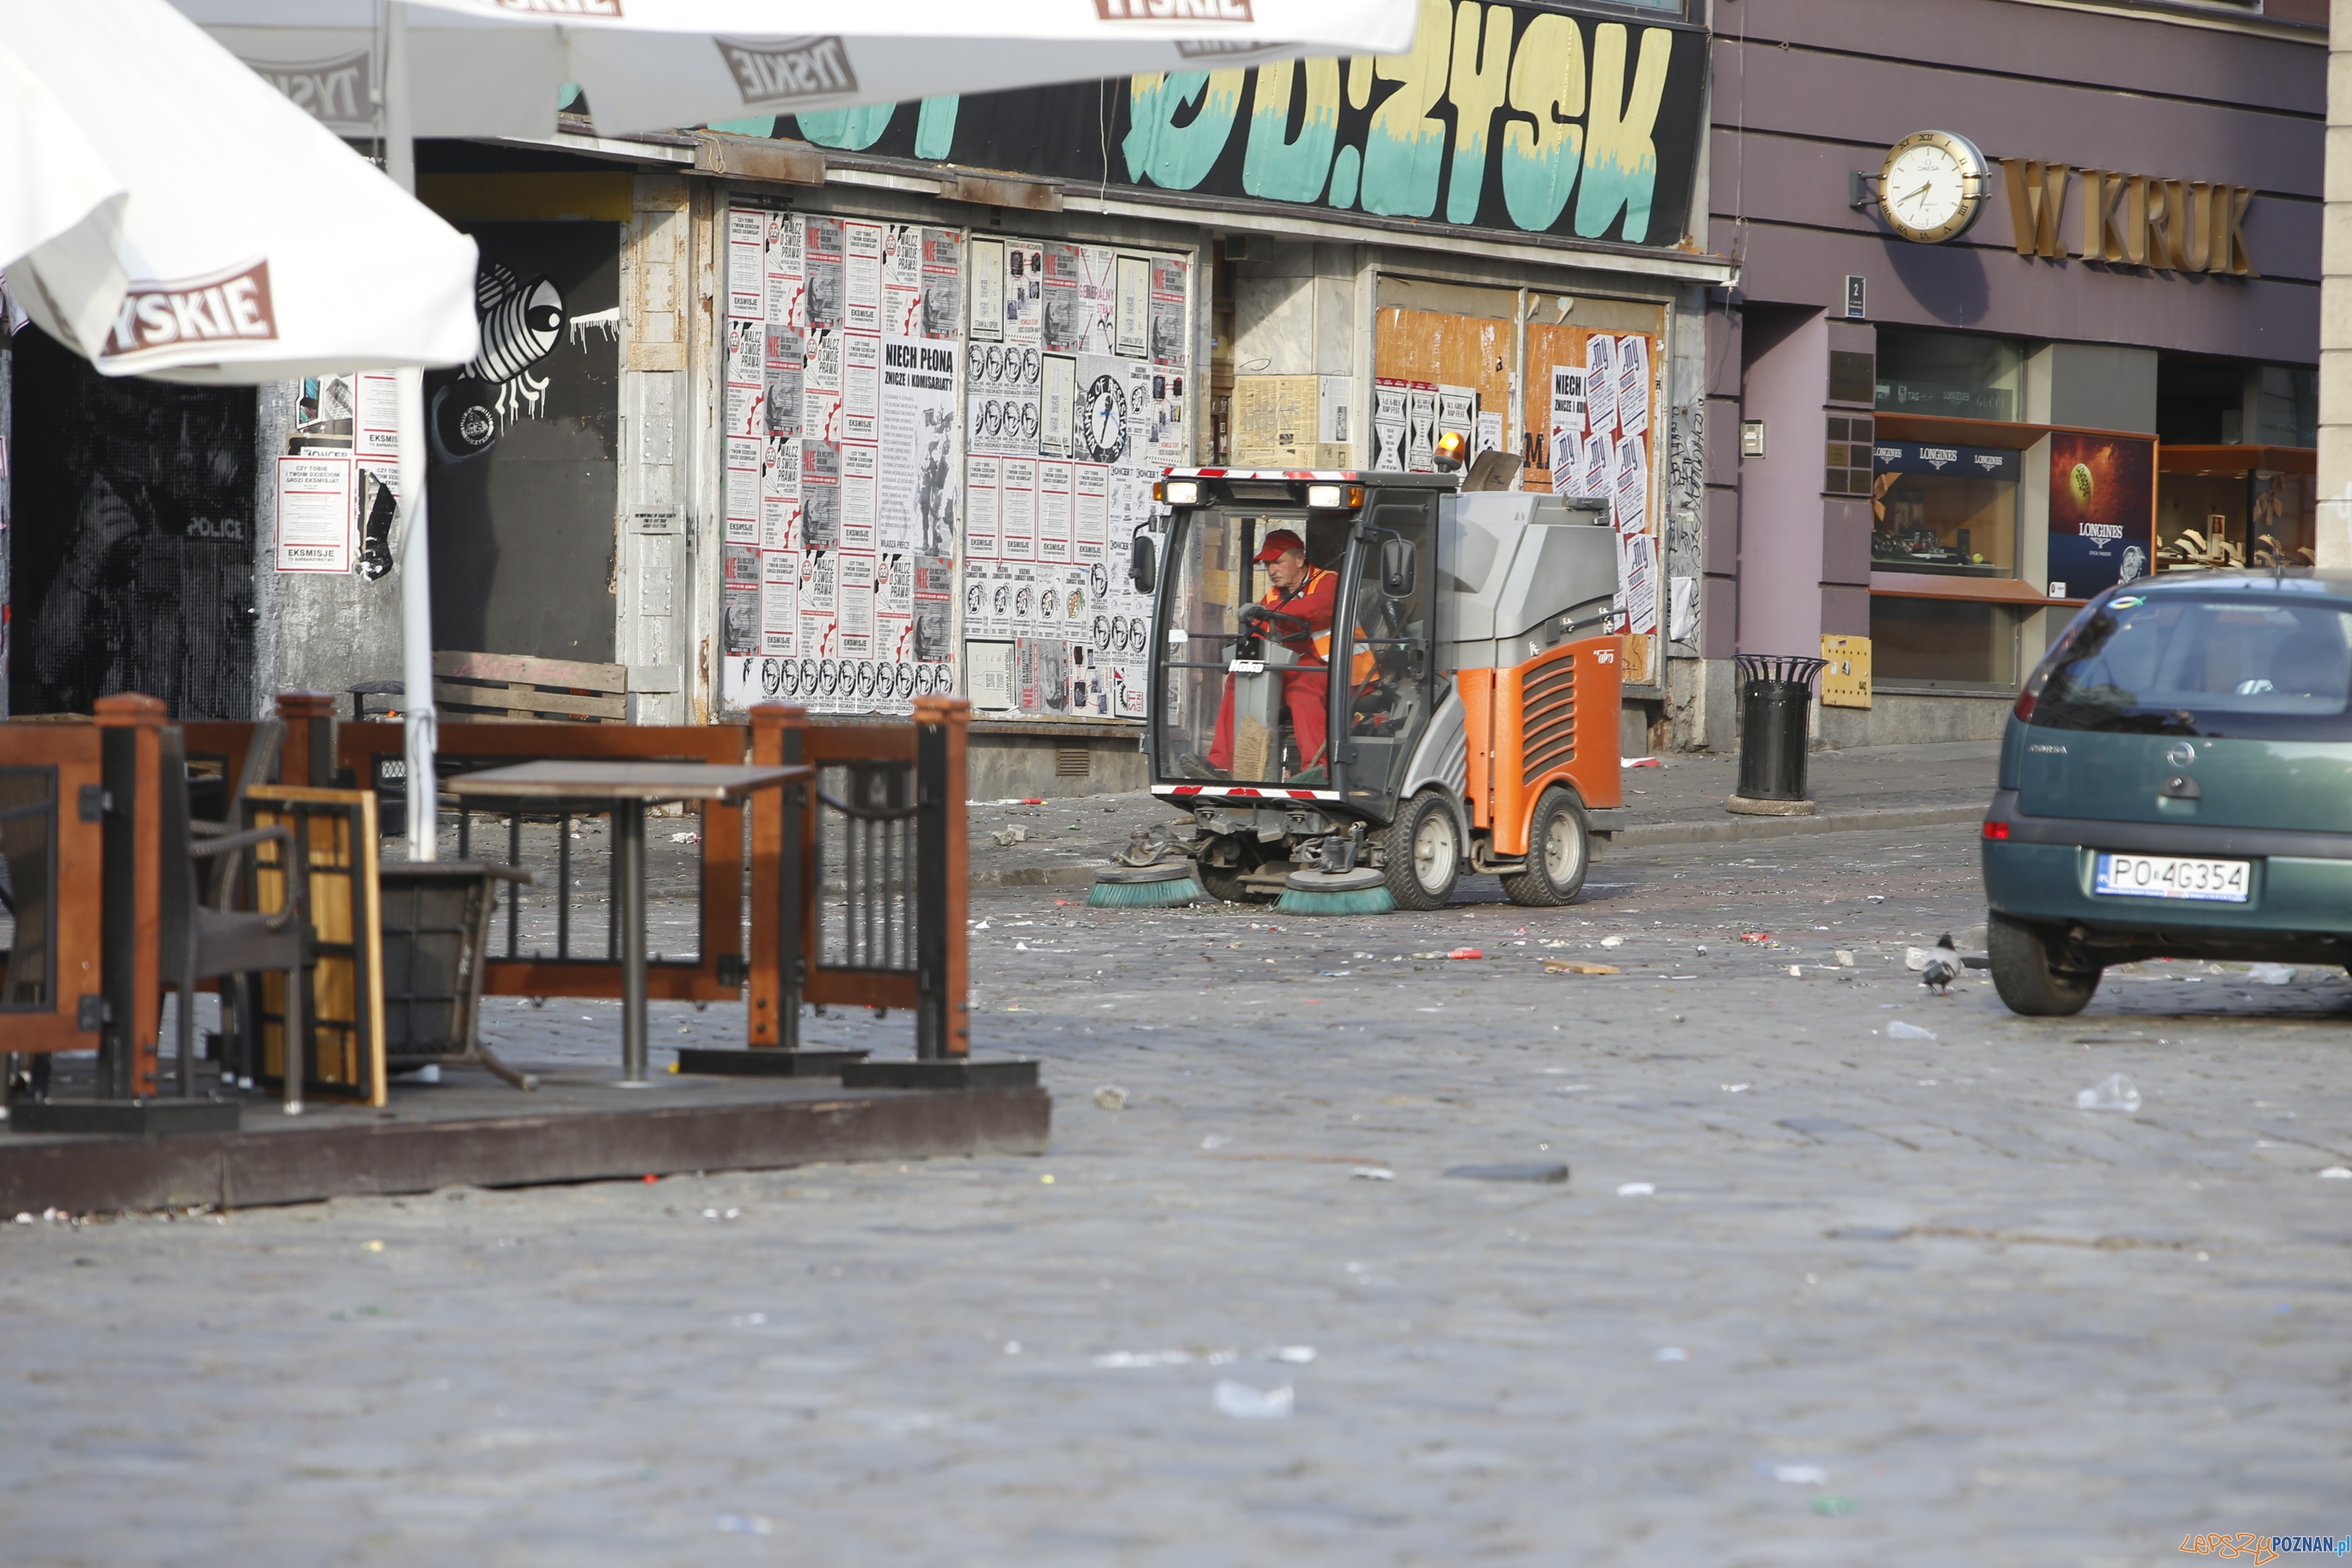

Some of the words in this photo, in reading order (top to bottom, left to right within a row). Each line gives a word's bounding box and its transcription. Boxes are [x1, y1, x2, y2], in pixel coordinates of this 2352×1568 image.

[1899, 139, 1910, 150] XI
[2000, 158, 2072, 257] W.
[2079, 168, 2259, 278] KRUK
[784, 221, 802, 235] WALCZ
[785, 235, 801, 247] SWOJE
[901, 233, 918, 247] WALCZ
[901, 248, 917, 259] SWOJE
[1080, 285, 1114, 301] GENERALNY
[1853, 284, 1859, 296] 2
[734, 297, 757, 306] EKSMISJE
[107, 276, 269, 352] YSKIE
[851, 309, 874, 318] EKSMISJE
[1097, 303, 1114, 315] STRAJK
[744, 330, 762, 344] WALCZ
[744, 344, 762, 355] SWOJE
[822, 337, 840, 351] WALCZ
[823, 351, 839, 362] SWOJE
[885, 344, 917, 369] NIECH
[920, 347, 953, 377] PŁONĄ
[885, 371, 906, 386] ZNICZE
[911, 374, 952, 391] KOMISARIATY
[1095, 378, 1106, 395] OF
[1556, 375, 1581, 396] NIECH
[1554, 399, 1571, 412] ZNICZE
[848, 420, 872, 428] EKSMISJE
[781, 445, 799, 457] WALCZ
[1874, 448, 1902, 458] LONGINES
[1920, 448, 1957, 462] LONGINES
[781, 458, 798, 470] SWOJE
[1974, 456, 2003, 465] LONGINES
[187, 518, 244, 539] POLICE
[729, 523, 753, 531] EKSMISJE
[2079, 523, 2123, 539] LONGINES
[846, 529, 869, 538] EKSMISJE
[817, 559, 835, 571] WALCZ
[894, 561, 911, 574] WALCZ
[818, 571, 834, 584] SWOJE
[894, 574, 910, 586] SWOJE
[767, 636, 790, 645] EKSMISJE
[844, 639, 867, 647] EKSMISJE
[1228, 659, 1265, 674] Hako
[2029, 744, 2067, 755] CORSA
[2115, 859, 2152, 885] PO
[2162, 861, 2243, 891] 4G354
